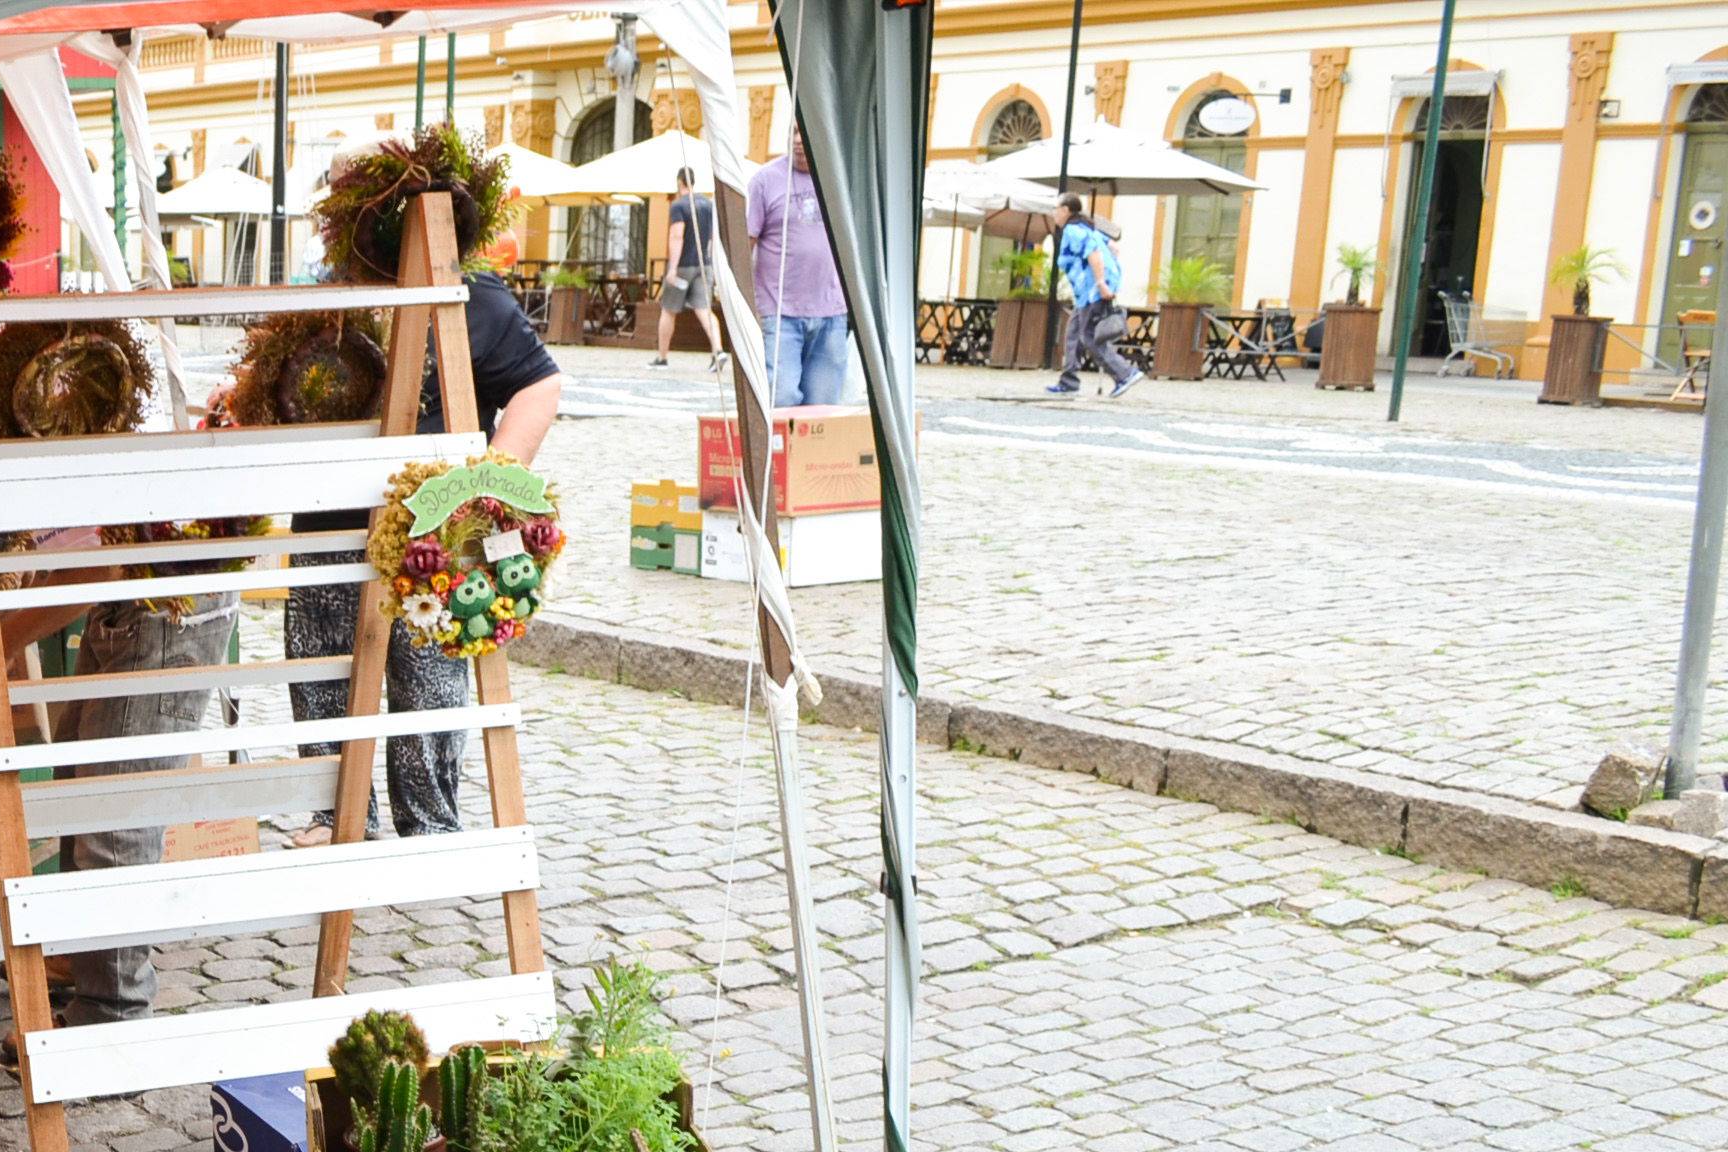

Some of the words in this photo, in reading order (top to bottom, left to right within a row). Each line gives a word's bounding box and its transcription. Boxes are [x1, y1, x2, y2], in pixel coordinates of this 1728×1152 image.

[712, 428, 722, 438] LG
[811, 424, 824, 434] LG
[469, 469, 538, 503] Morada
